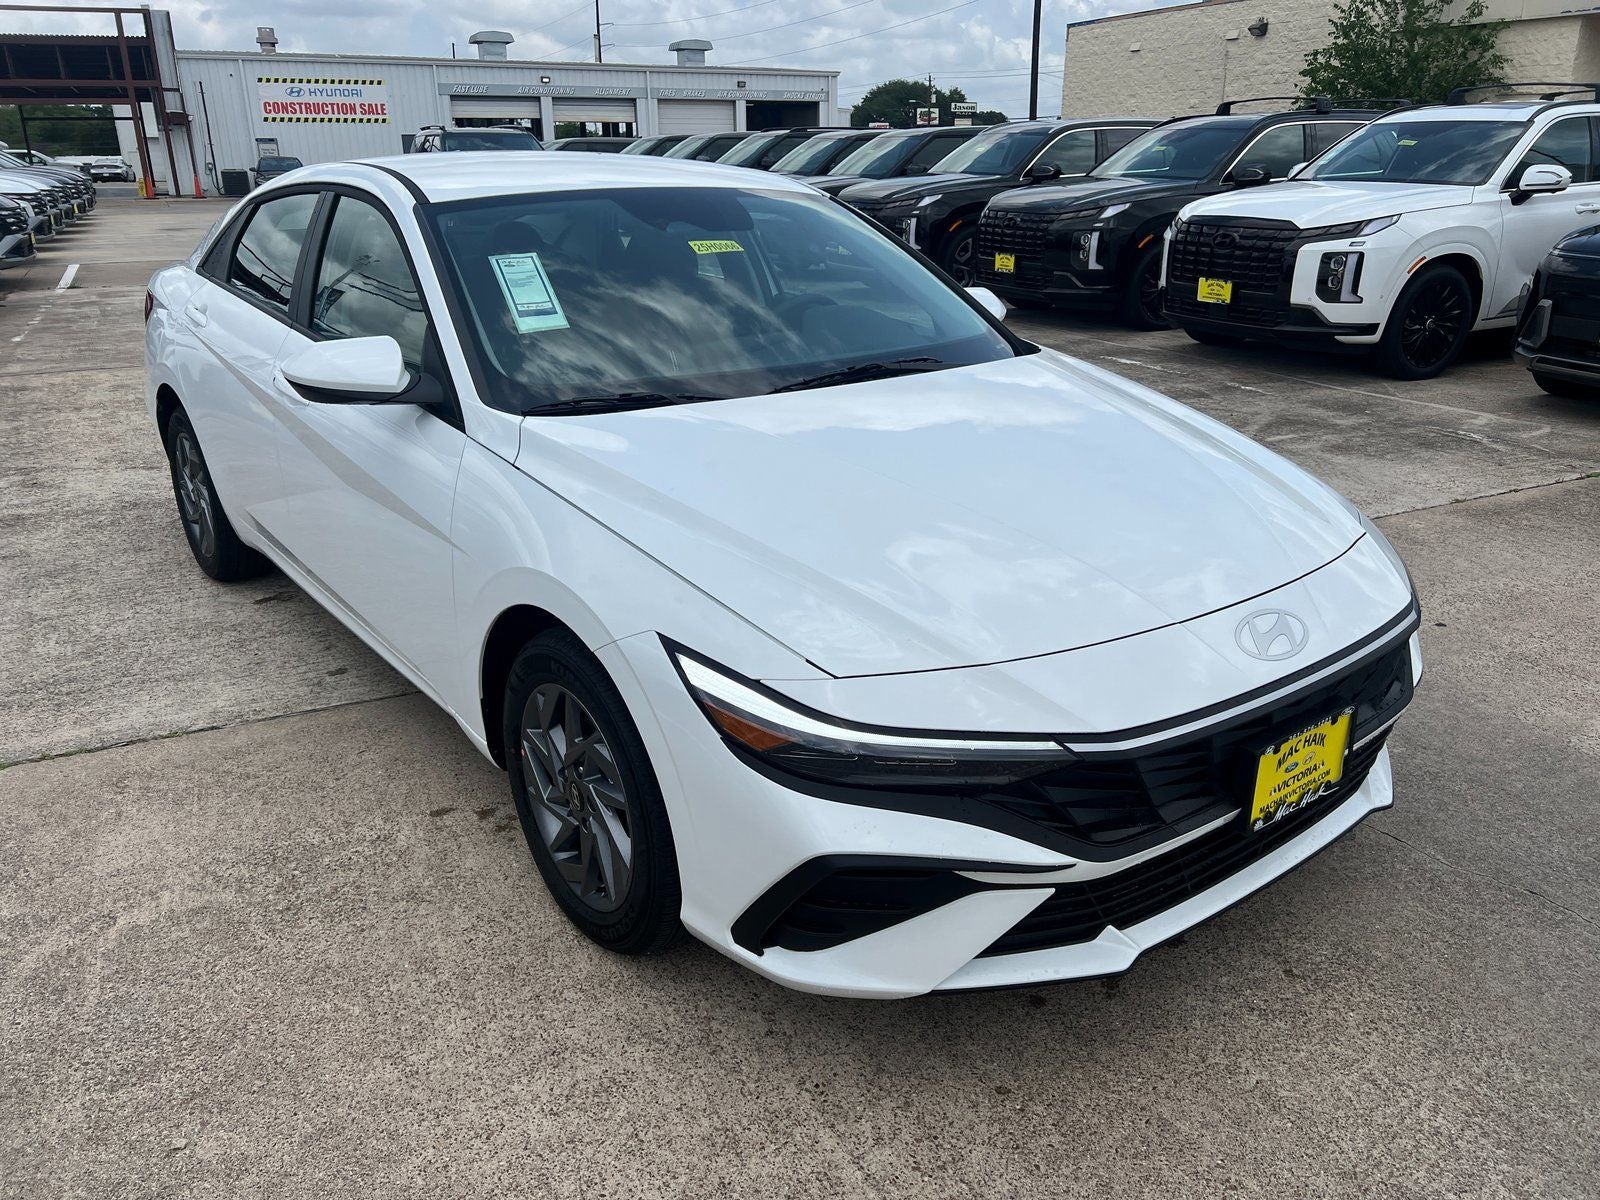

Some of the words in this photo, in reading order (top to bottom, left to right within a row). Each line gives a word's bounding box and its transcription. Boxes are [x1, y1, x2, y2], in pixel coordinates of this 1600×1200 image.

[309, 88, 362, 98] HYUNDAI
[452, 85, 470, 94] FAST
[470, 86, 488, 94] LUBE
[516, 87, 530, 95] AIR
[530, 87, 575, 96] CONDITIONING
[594, 88, 632, 96] ALIGNMENT
[659, 89, 677, 97] TIRES
[683, 90, 706, 98] BRAKES
[717, 90, 729, 98] AIR
[729, 91, 769, 99] CONDITIONING
[263, 101, 358, 116] CONSTRUCTION
[359, 102, 387, 116] SALE
[952, 103, 976, 111] Jason
[1276, 739, 1303, 773] MAC
[1303, 732, 1327, 749] HAIK
[1277, 763, 1318, 793] VICTORIA
[1258, 769, 1331, 815] MACHAIKVICTORIA.COM
[1274, 802, 1298, 822] Mac
